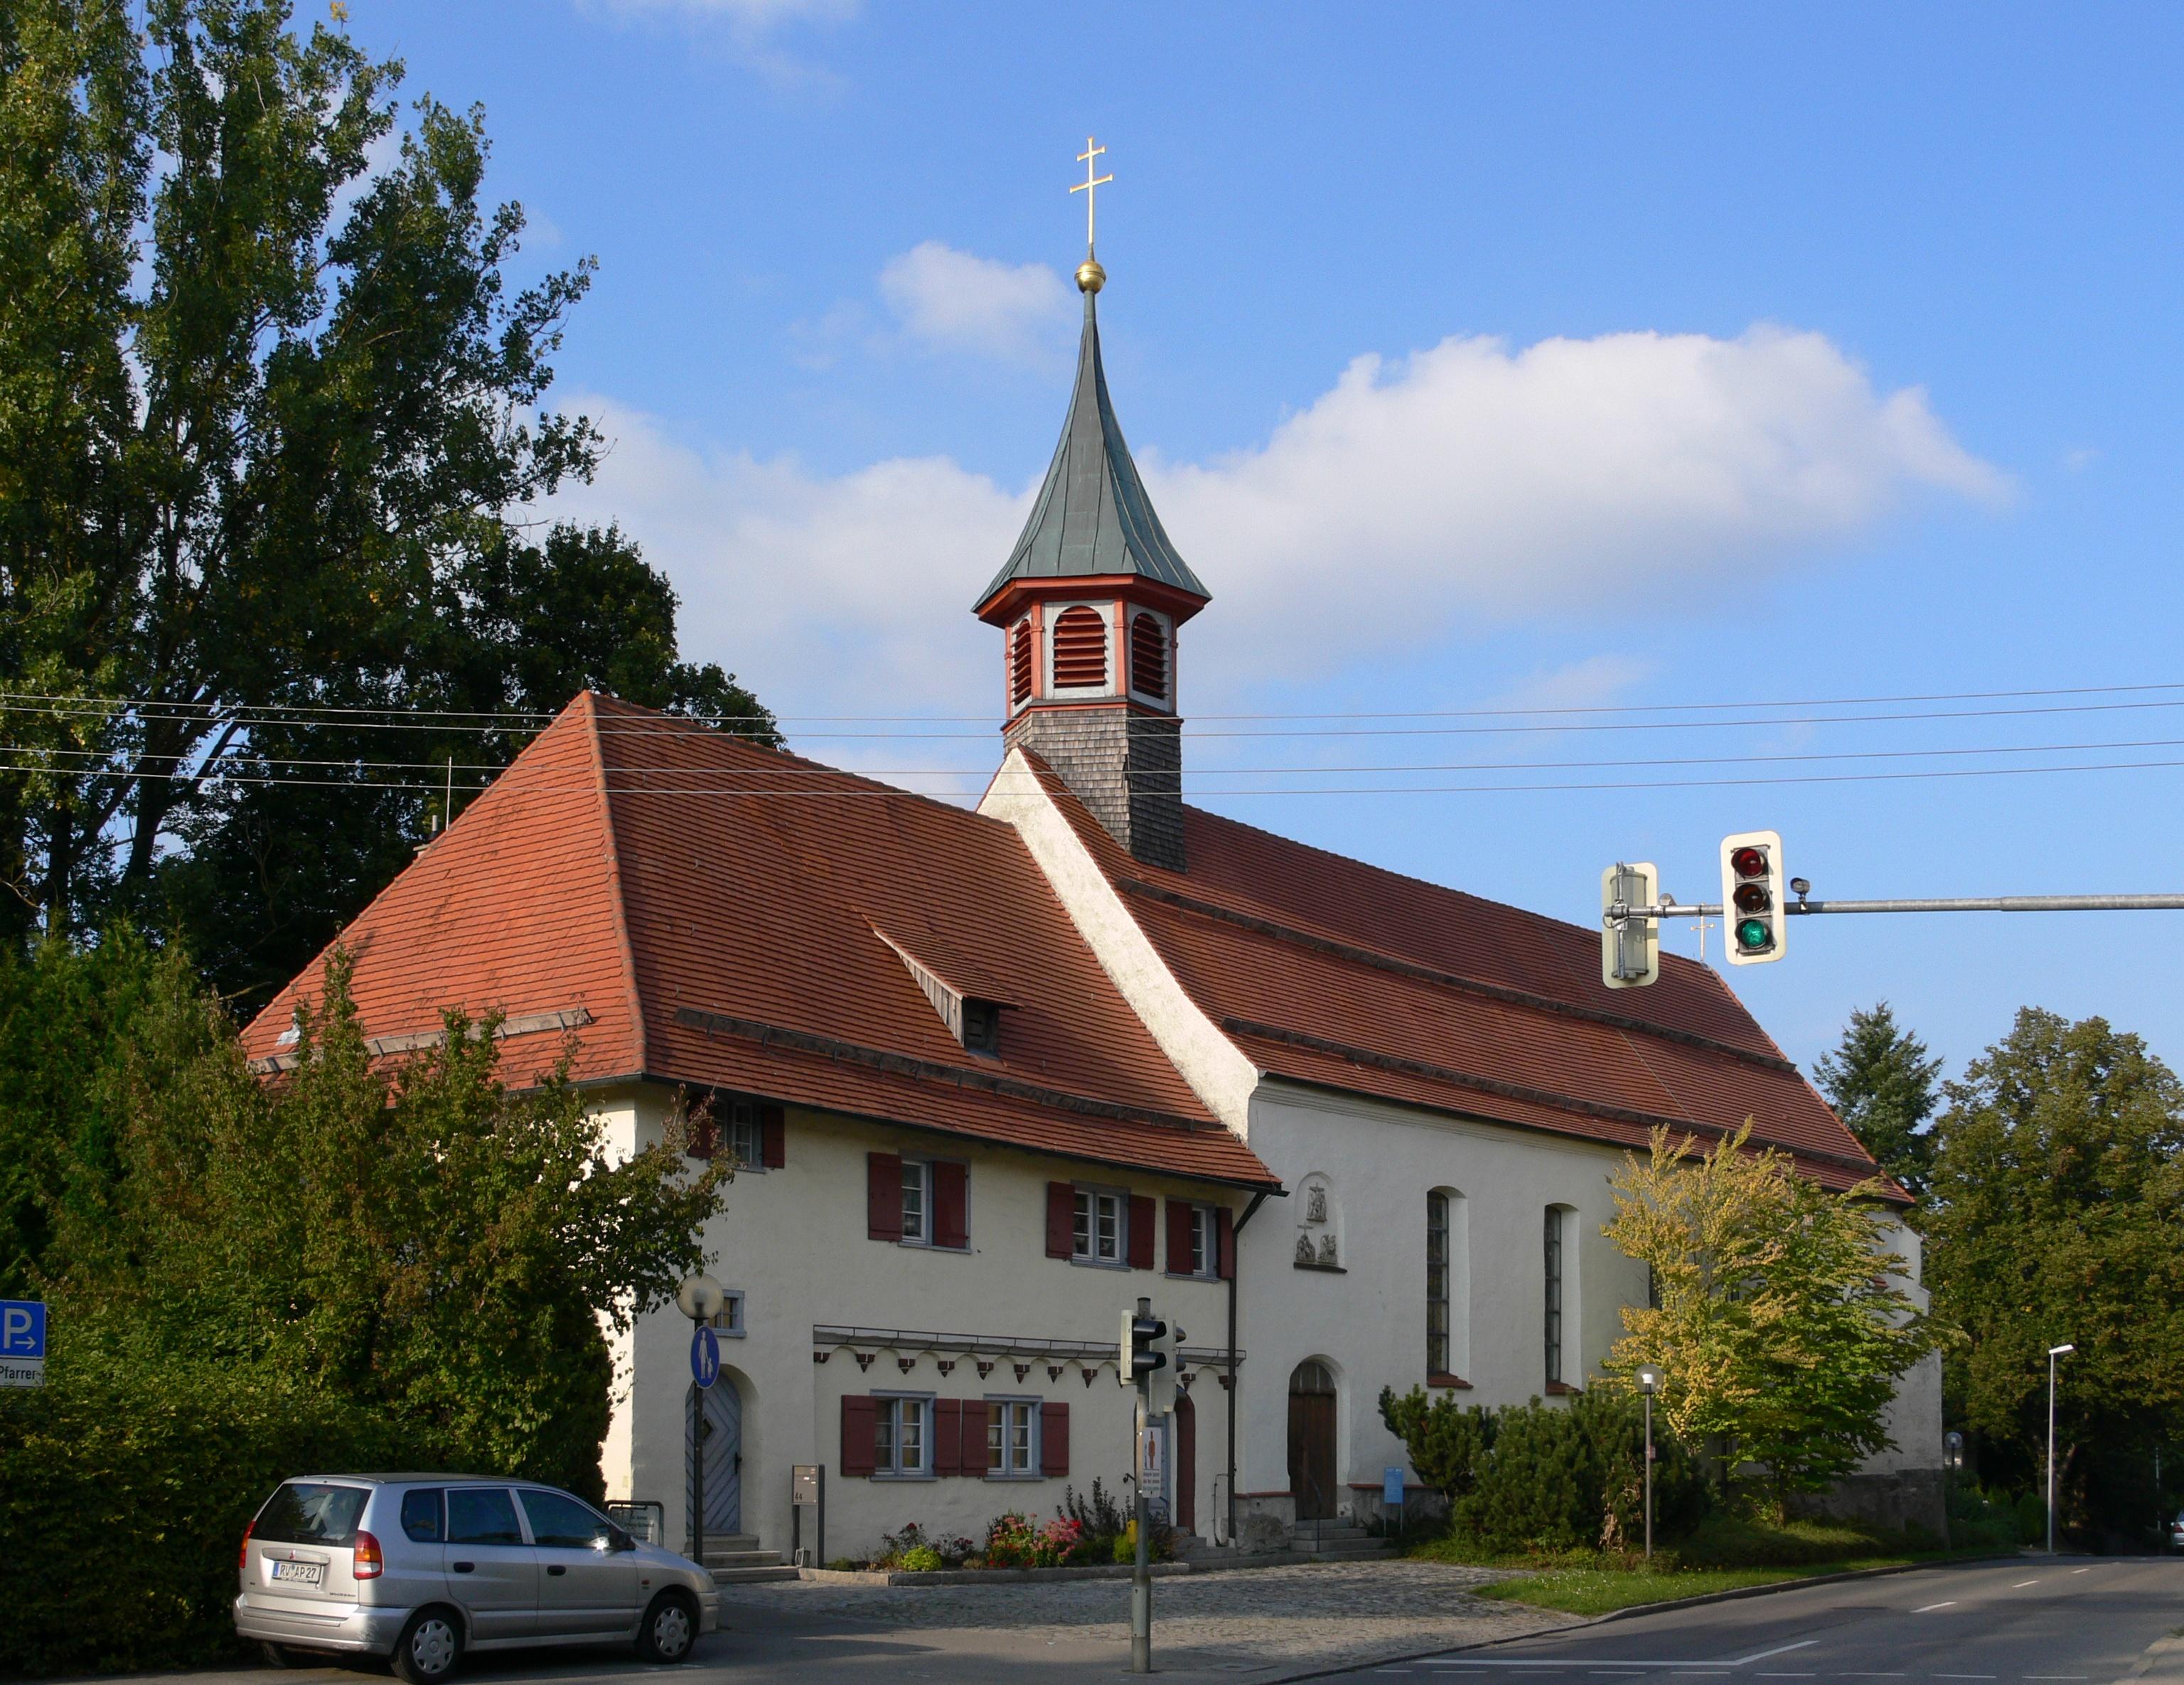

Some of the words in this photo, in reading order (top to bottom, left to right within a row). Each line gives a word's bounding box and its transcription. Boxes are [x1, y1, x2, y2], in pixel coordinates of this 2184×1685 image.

[4, 1308, 33, 1349] P
[279, 1565, 291, 1576] RV
[294, 1566, 305, 1578] AP
[306, 1567, 317, 1579] 27
